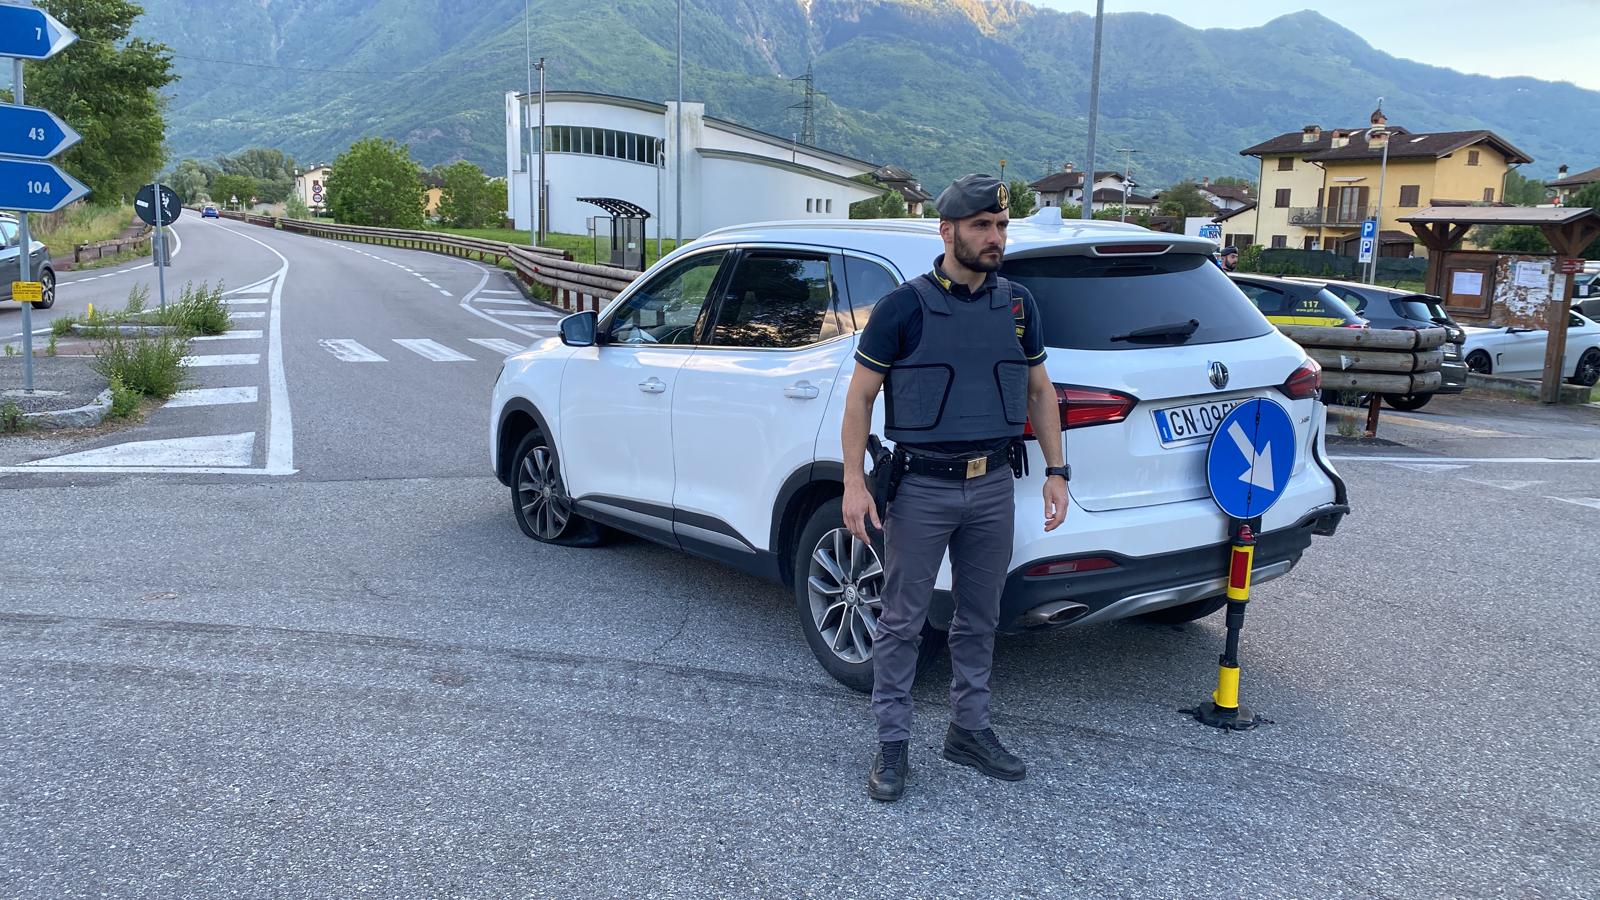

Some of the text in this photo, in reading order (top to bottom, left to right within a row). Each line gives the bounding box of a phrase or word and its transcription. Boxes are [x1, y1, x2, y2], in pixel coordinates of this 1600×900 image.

[35, 27, 42, 40] 7
[28, 127, 45, 141] 43
[27, 181, 51, 194] 104
[1364, 222, 1373, 236] P
[1363, 241, 1370, 252] P
[1170, 402, 1238, 436] GN 09
